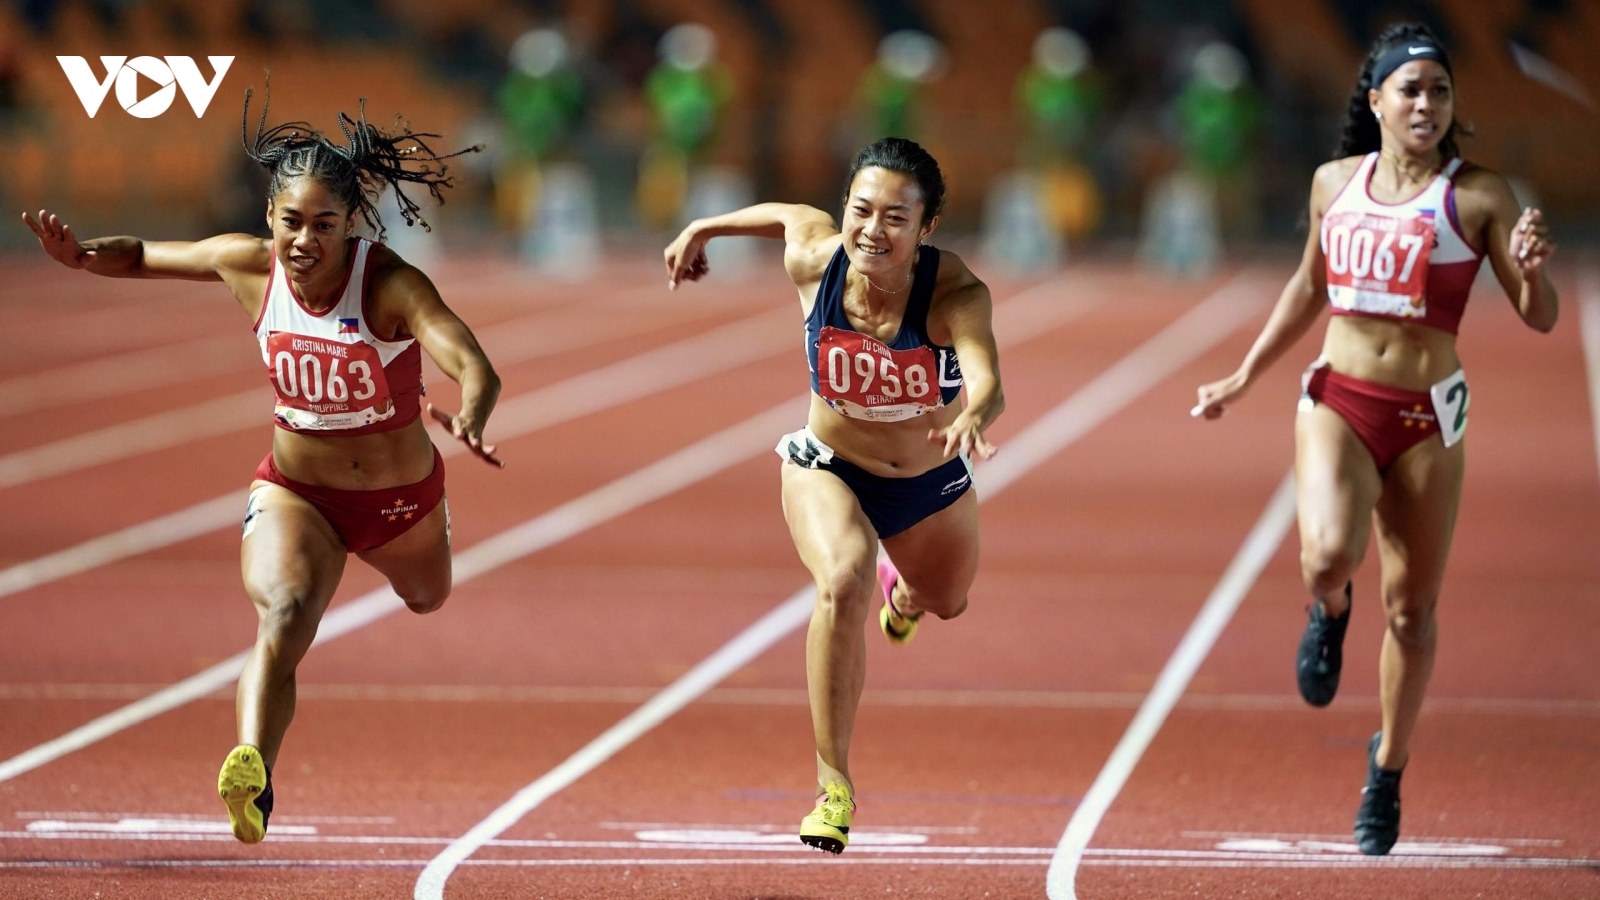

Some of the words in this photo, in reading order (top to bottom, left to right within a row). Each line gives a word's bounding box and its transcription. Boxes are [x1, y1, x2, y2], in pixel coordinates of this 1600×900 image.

[1329, 224, 1424, 283] 0067
[292, 338, 325, 353] KRISTINA
[326, 343, 348, 358] MARIE
[862, 338, 872, 351] TU
[275, 351, 376, 403] 0063
[828, 346, 930, 398] 0958
[865, 394, 896, 405] VIETNAM
[1446, 381, 1467, 433] 2
[381, 503, 419, 515] PILIPINAS
